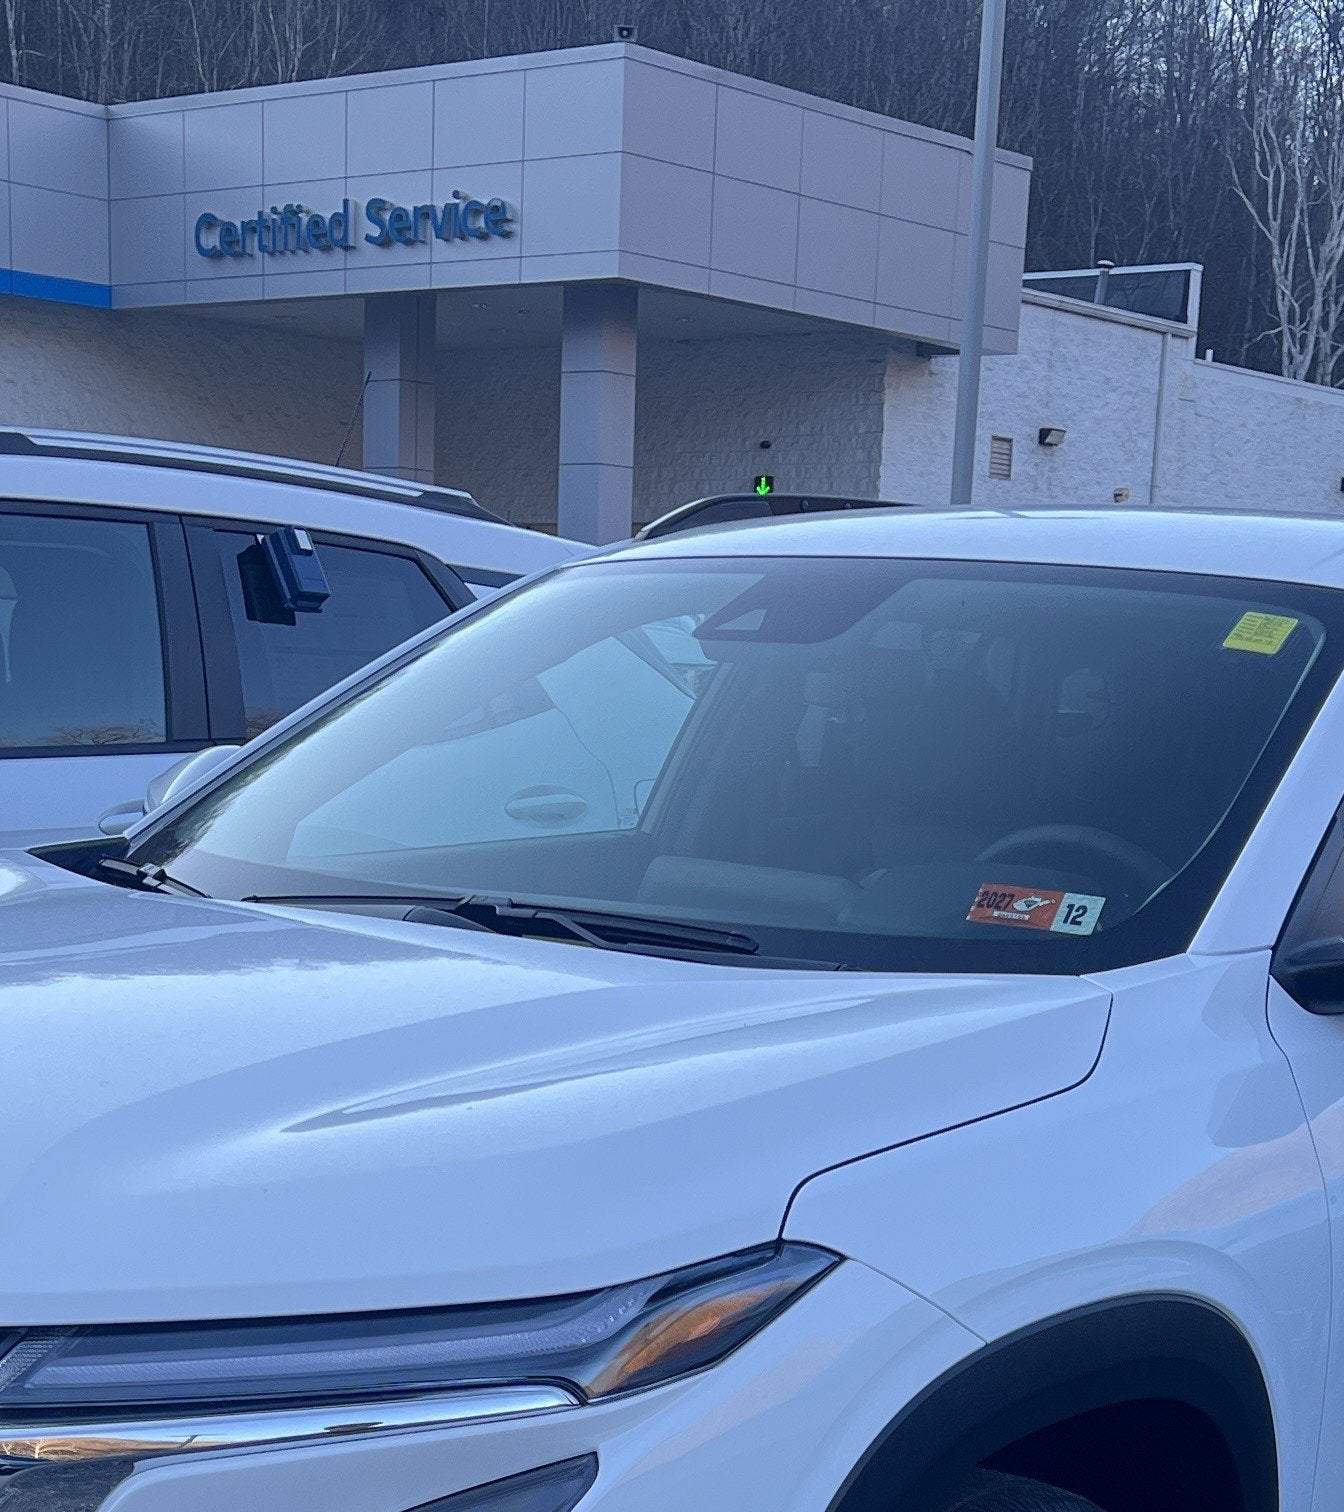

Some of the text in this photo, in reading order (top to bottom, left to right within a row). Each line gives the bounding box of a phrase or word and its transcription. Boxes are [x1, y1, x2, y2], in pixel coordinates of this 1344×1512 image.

[194, 189, 514, 258] Certified Service
[976, 890, 1089, 927] 2027 12
